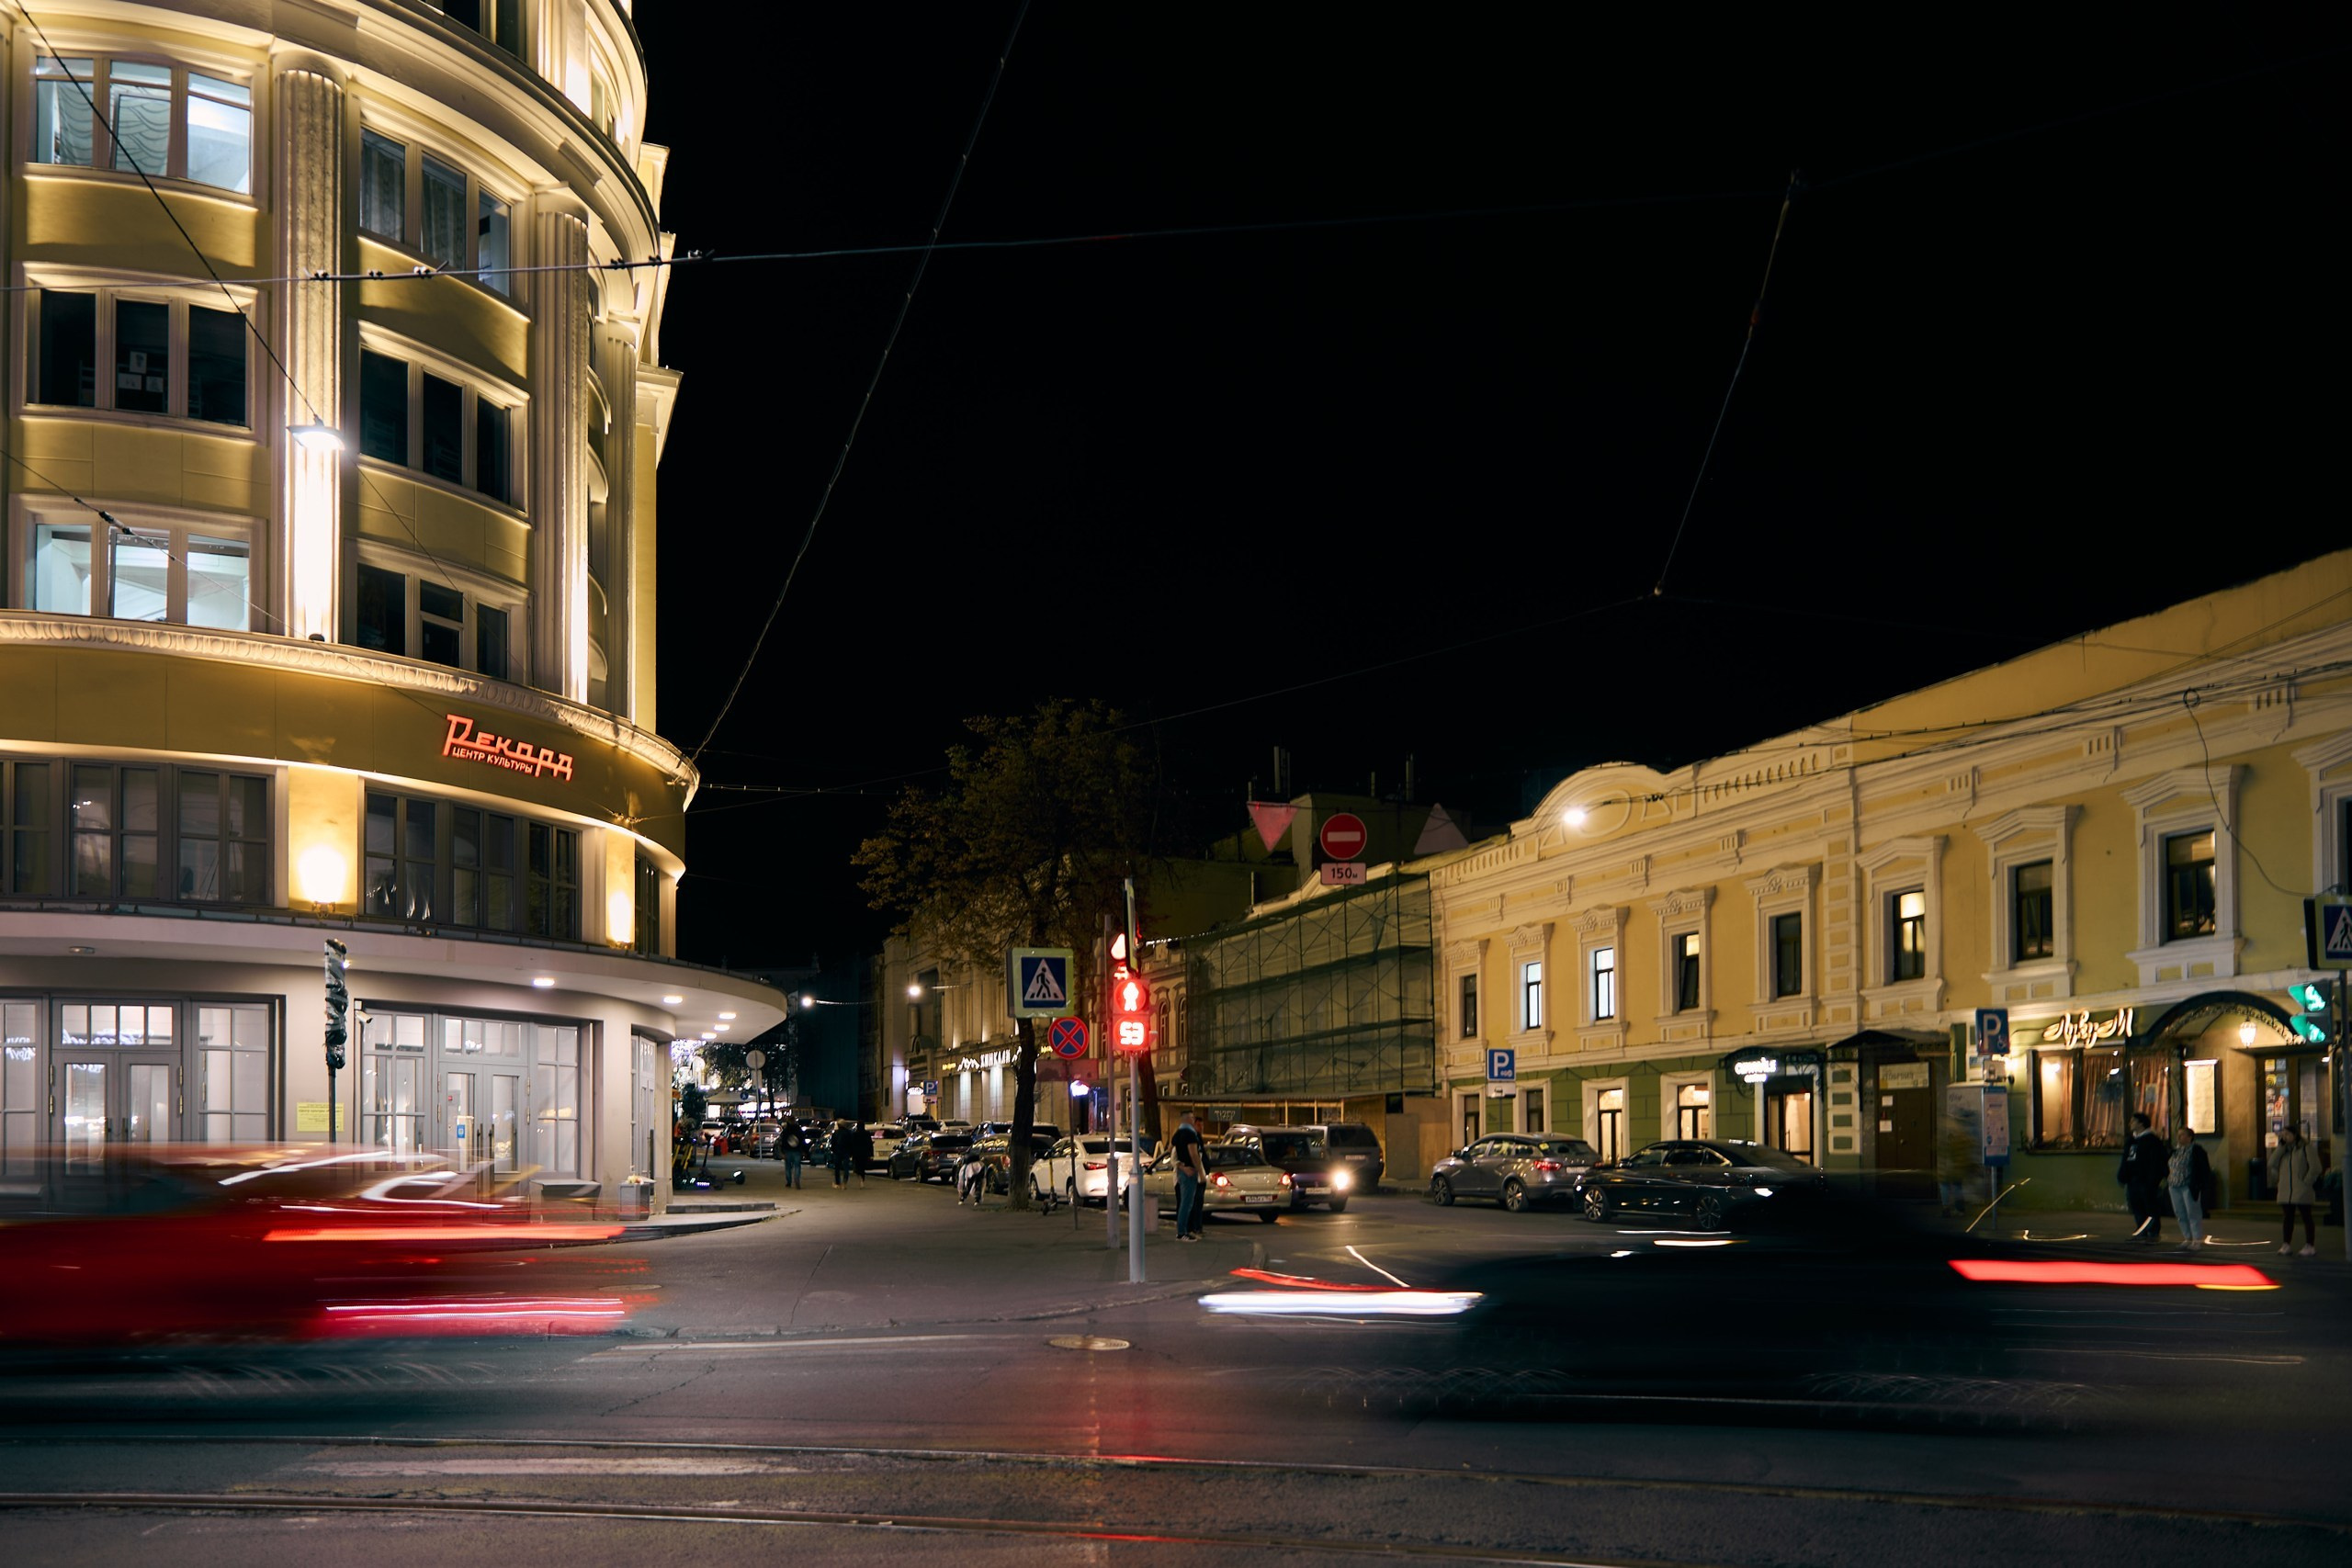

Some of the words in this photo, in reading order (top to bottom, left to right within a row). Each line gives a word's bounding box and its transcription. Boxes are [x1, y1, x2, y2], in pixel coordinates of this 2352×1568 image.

[452, 747, 486, 761] ЦЕНТР
[487, 753, 534, 774] КУЛЬТУРЫ
[1983, 1013, 2001, 1050] P
[1494, 1052, 1510, 1077] P
[926, 1082, 934, 1094] P
